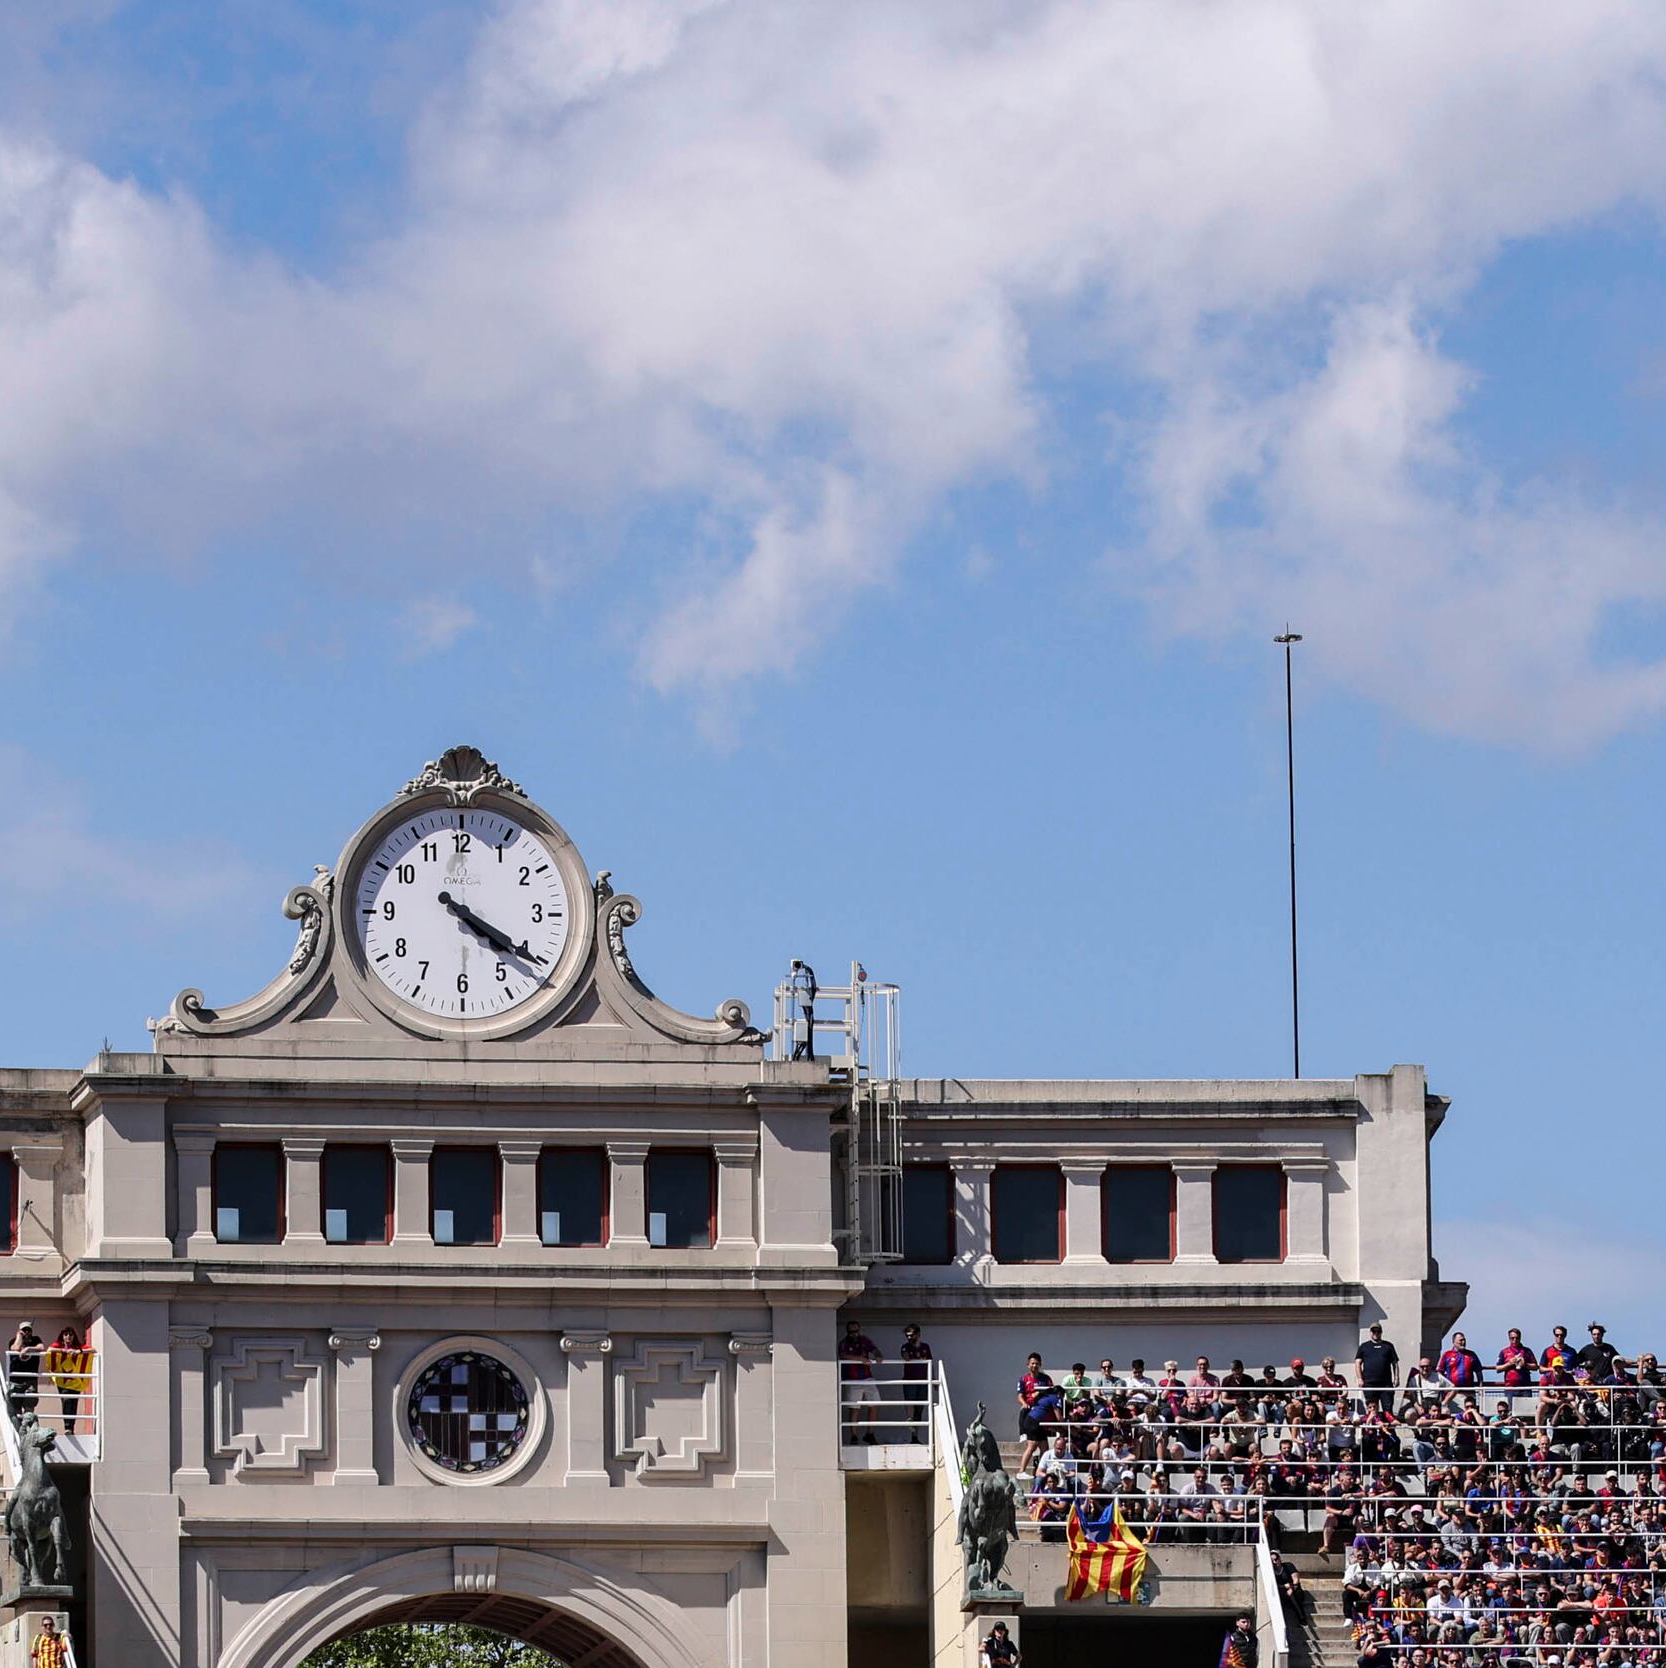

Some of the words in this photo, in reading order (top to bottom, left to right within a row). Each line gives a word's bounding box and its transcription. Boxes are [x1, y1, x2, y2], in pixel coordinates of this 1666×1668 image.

[421, 843, 437, 862] 11
[452, 834, 471, 853] 12
[495, 844, 503, 863] 1
[395, 864, 415, 884] 10
[518, 866, 530, 886] 2
[383, 901, 395, 920] 9
[531, 904, 543, 923] 3
[395, 938, 407, 957] 8
[418, 961, 430, 980] 7
[495, 962, 506, 982] 5
[457, 974, 469, 993] 6
